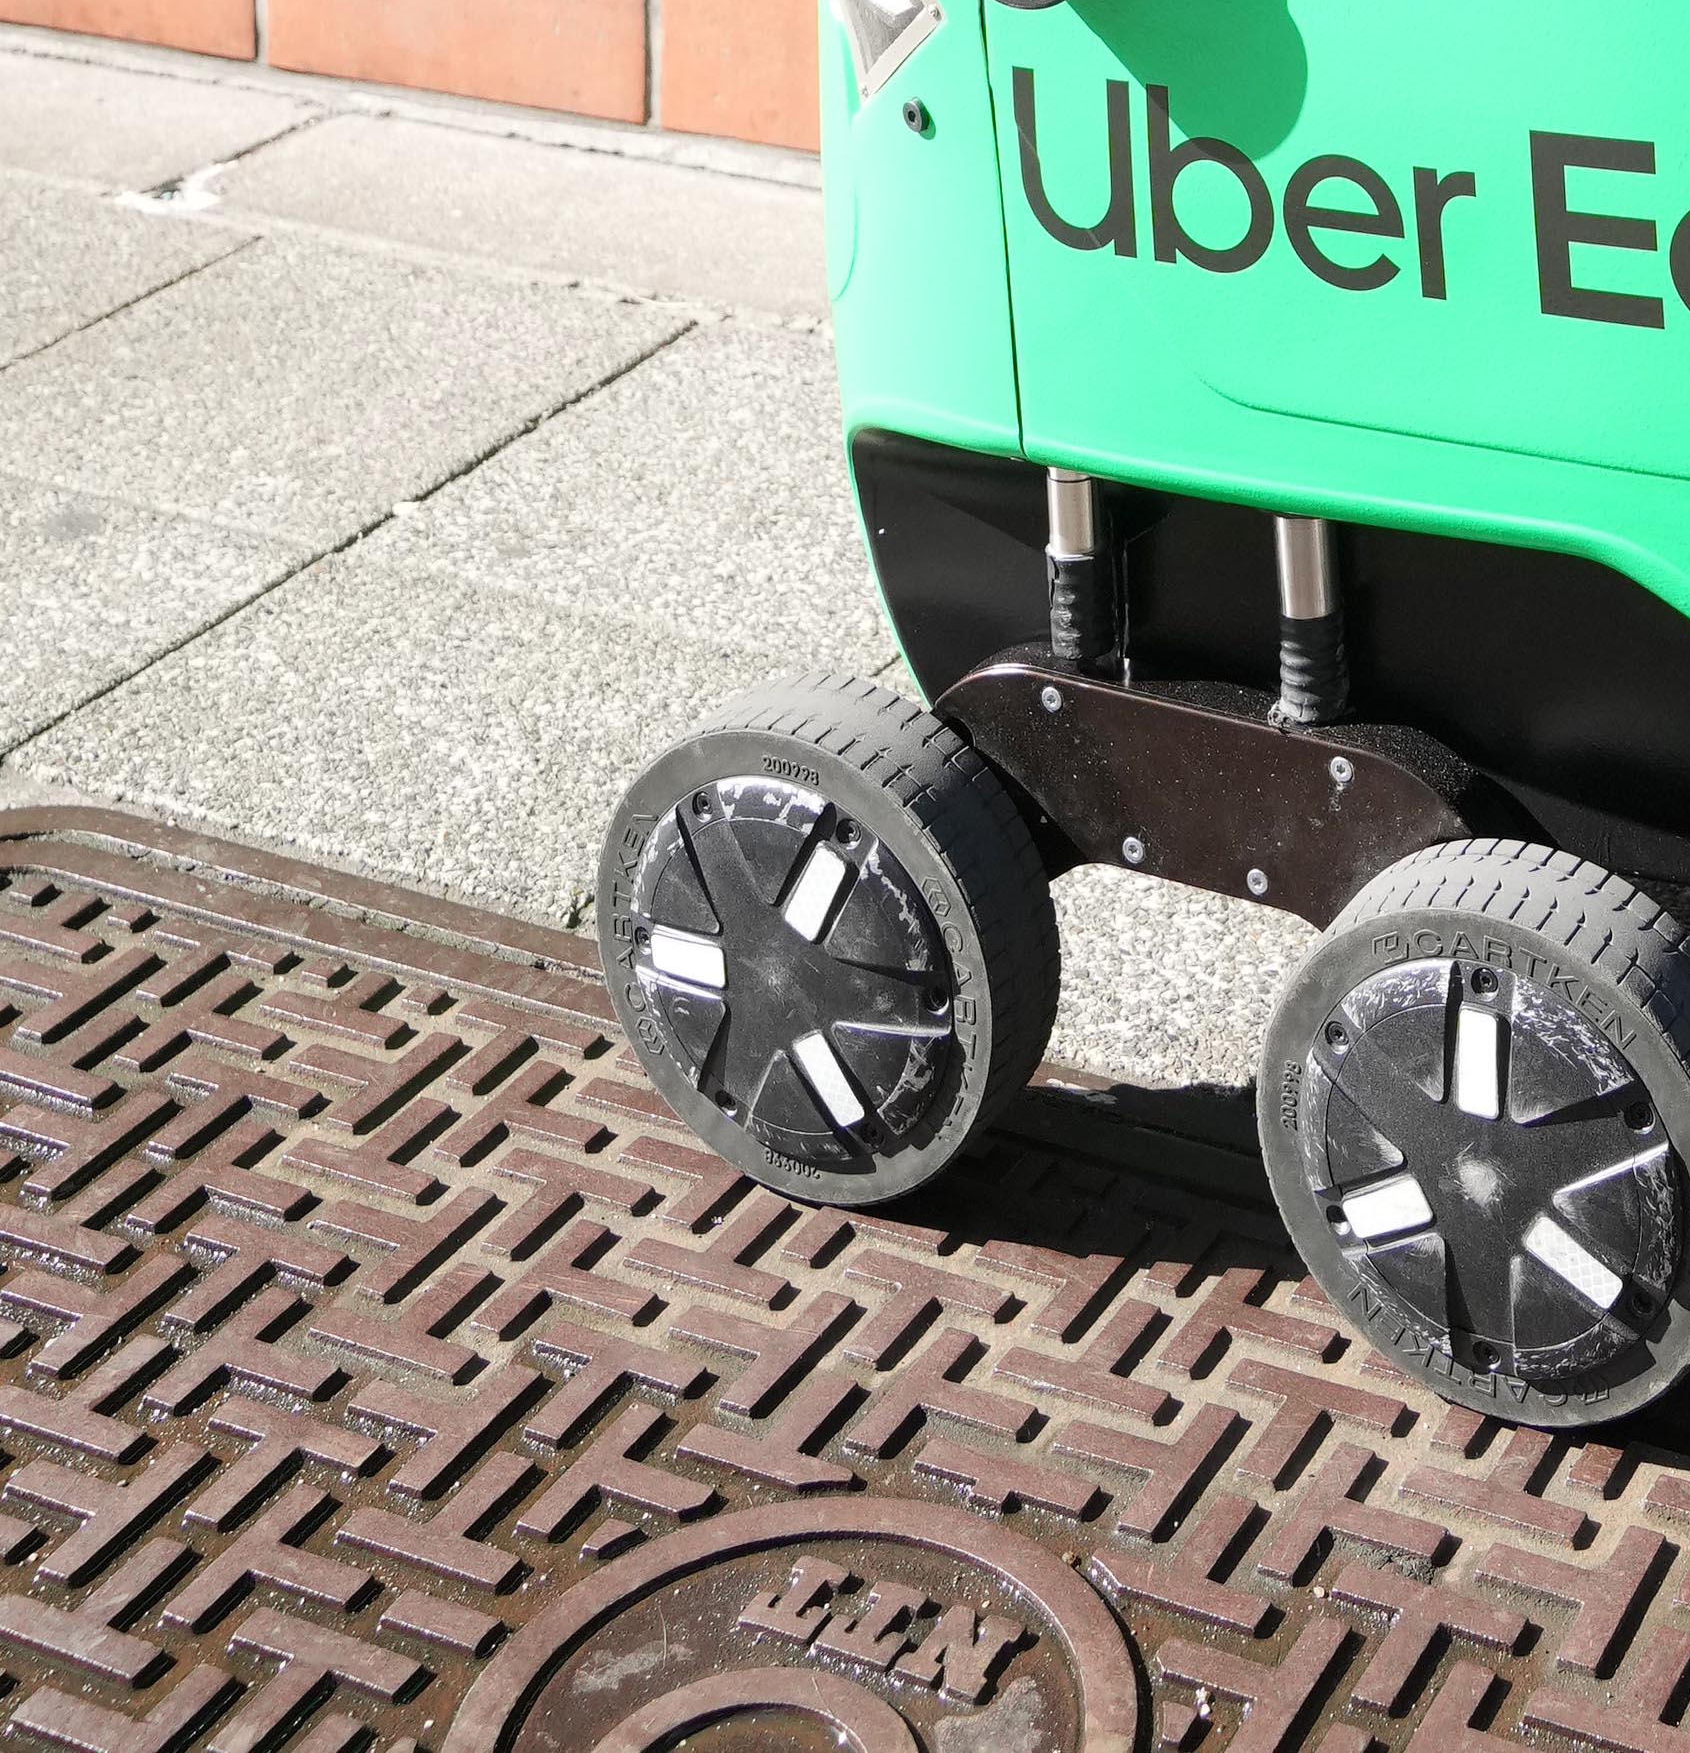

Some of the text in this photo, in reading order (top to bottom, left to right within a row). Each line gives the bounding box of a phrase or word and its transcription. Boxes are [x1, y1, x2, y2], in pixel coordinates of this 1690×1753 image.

[1011, 65, 1477, 301] Uber
[762, 754, 820, 787] 200998
[1413, 931, 1638, 1050] CARTKEN
